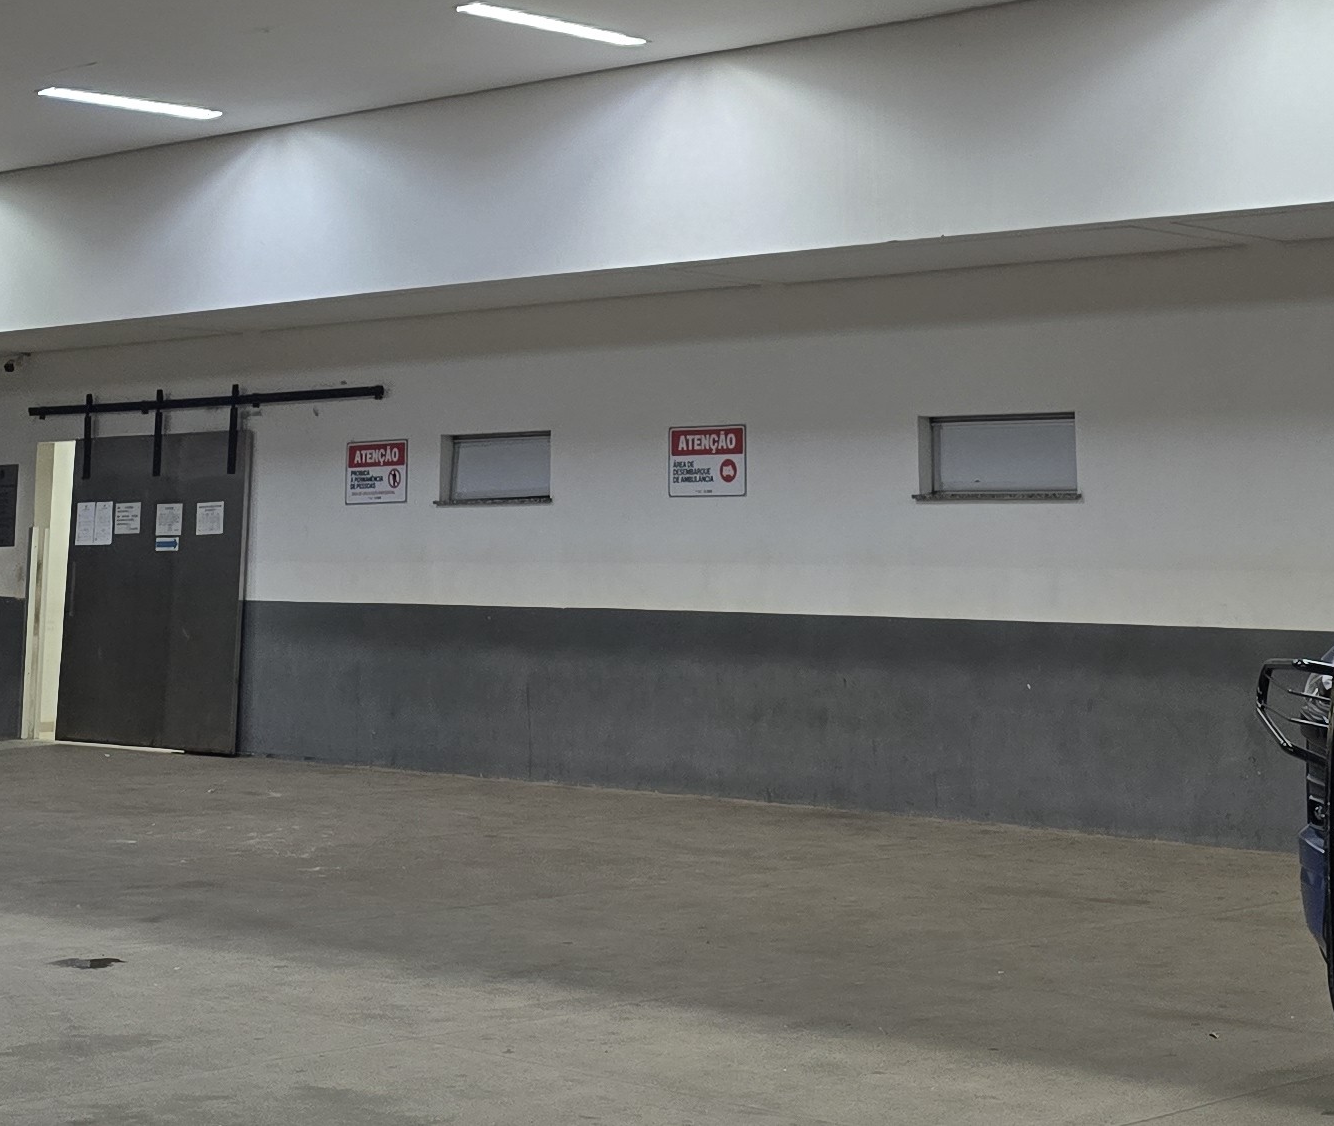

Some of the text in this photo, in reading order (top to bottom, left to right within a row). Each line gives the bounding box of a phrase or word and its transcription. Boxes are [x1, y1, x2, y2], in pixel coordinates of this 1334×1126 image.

[677, 430, 736, 454] ATENÇÃO
[353, 445, 399, 466] ATENÇÃO
[687, 460, 694, 468] DE
[672, 475, 680, 483] DE
